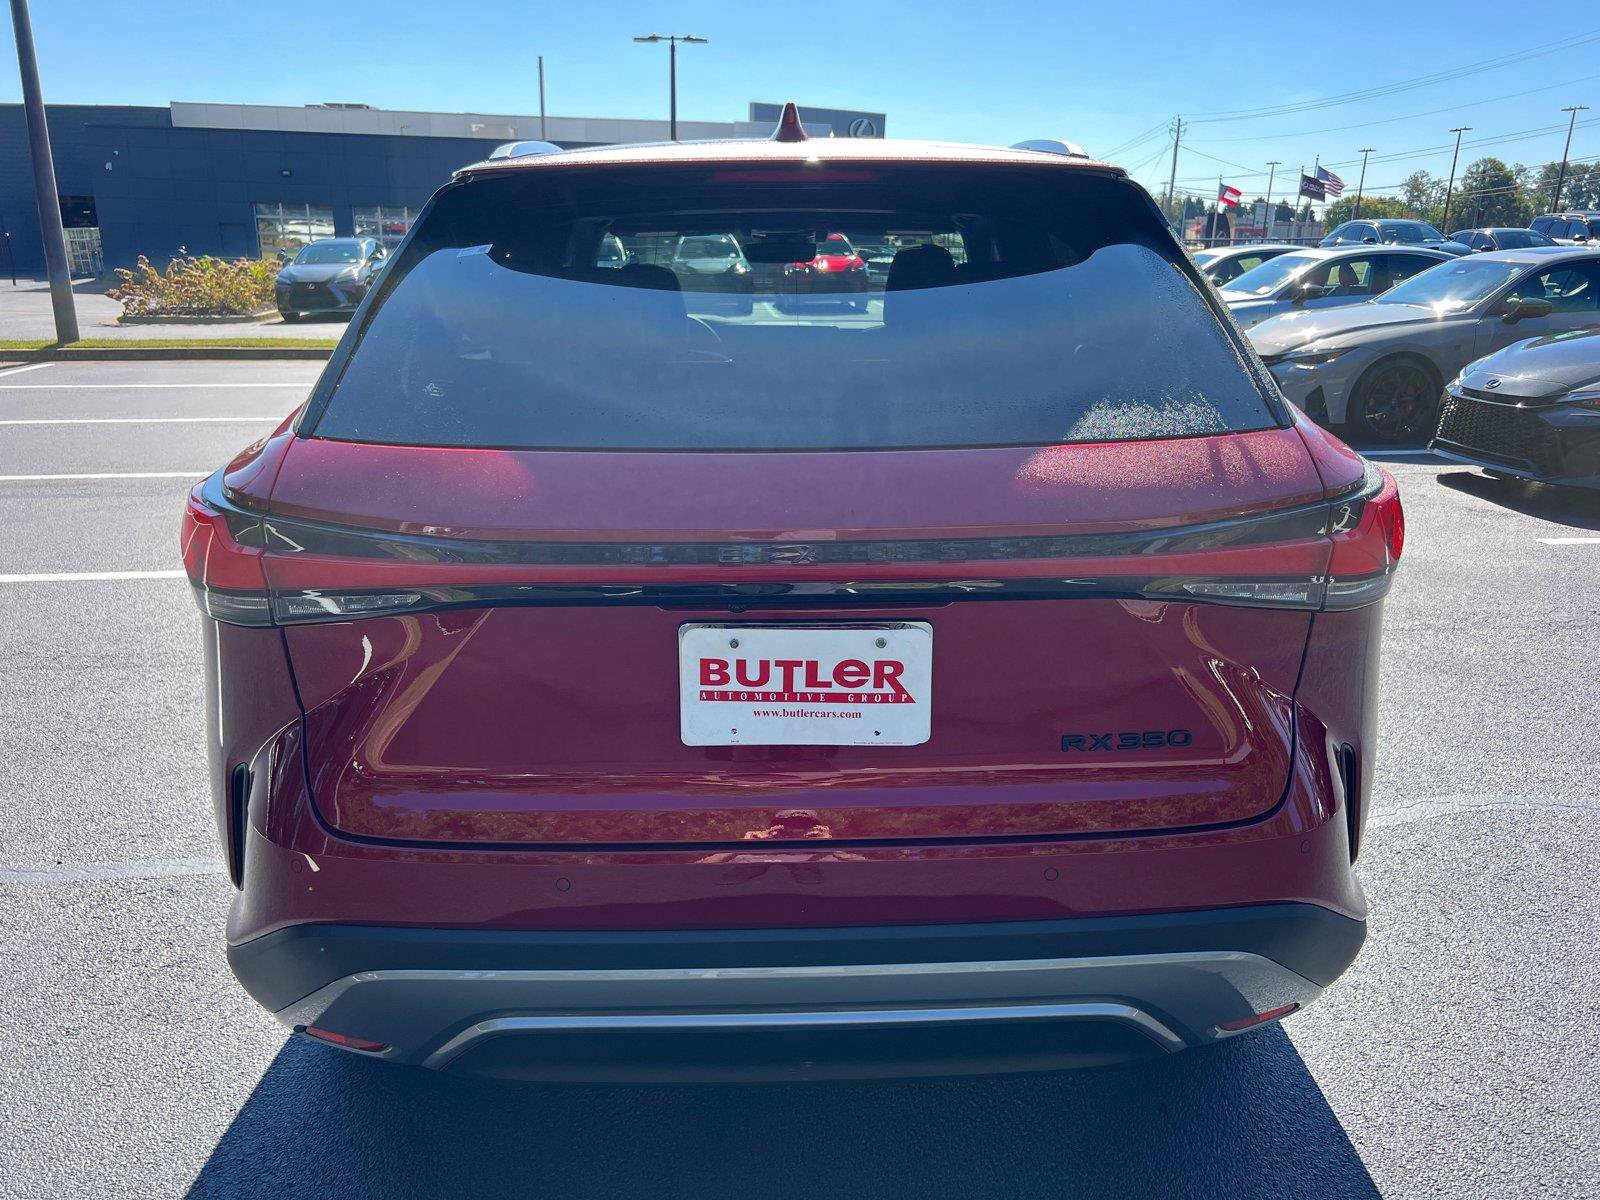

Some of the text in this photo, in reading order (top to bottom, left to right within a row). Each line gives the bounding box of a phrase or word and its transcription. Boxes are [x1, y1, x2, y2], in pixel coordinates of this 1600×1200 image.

[701, 692, 910, 703] AUTOMOTIVE GROUP
[753, 708, 862, 719] www.butlercars.com
